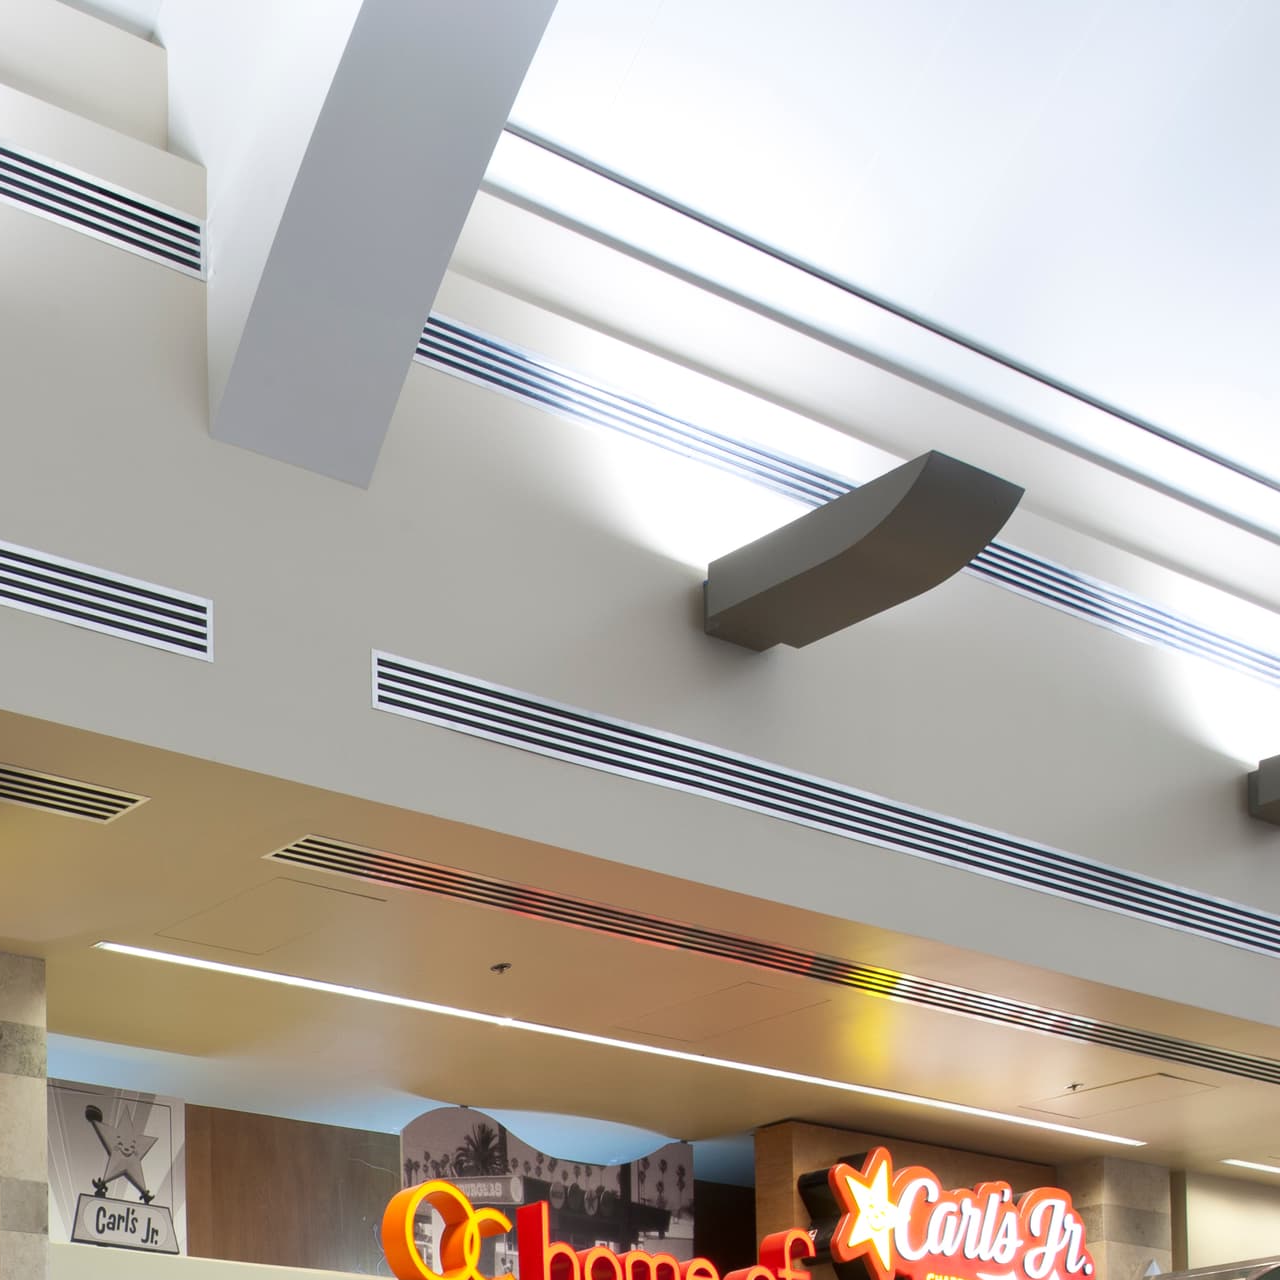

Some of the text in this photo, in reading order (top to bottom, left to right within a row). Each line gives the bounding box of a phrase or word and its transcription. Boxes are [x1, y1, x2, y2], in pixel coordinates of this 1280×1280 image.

[95, 1206, 159, 1245] Carl's Jr.
[894, 1177, 1093, 1280] Carl's Jr.
